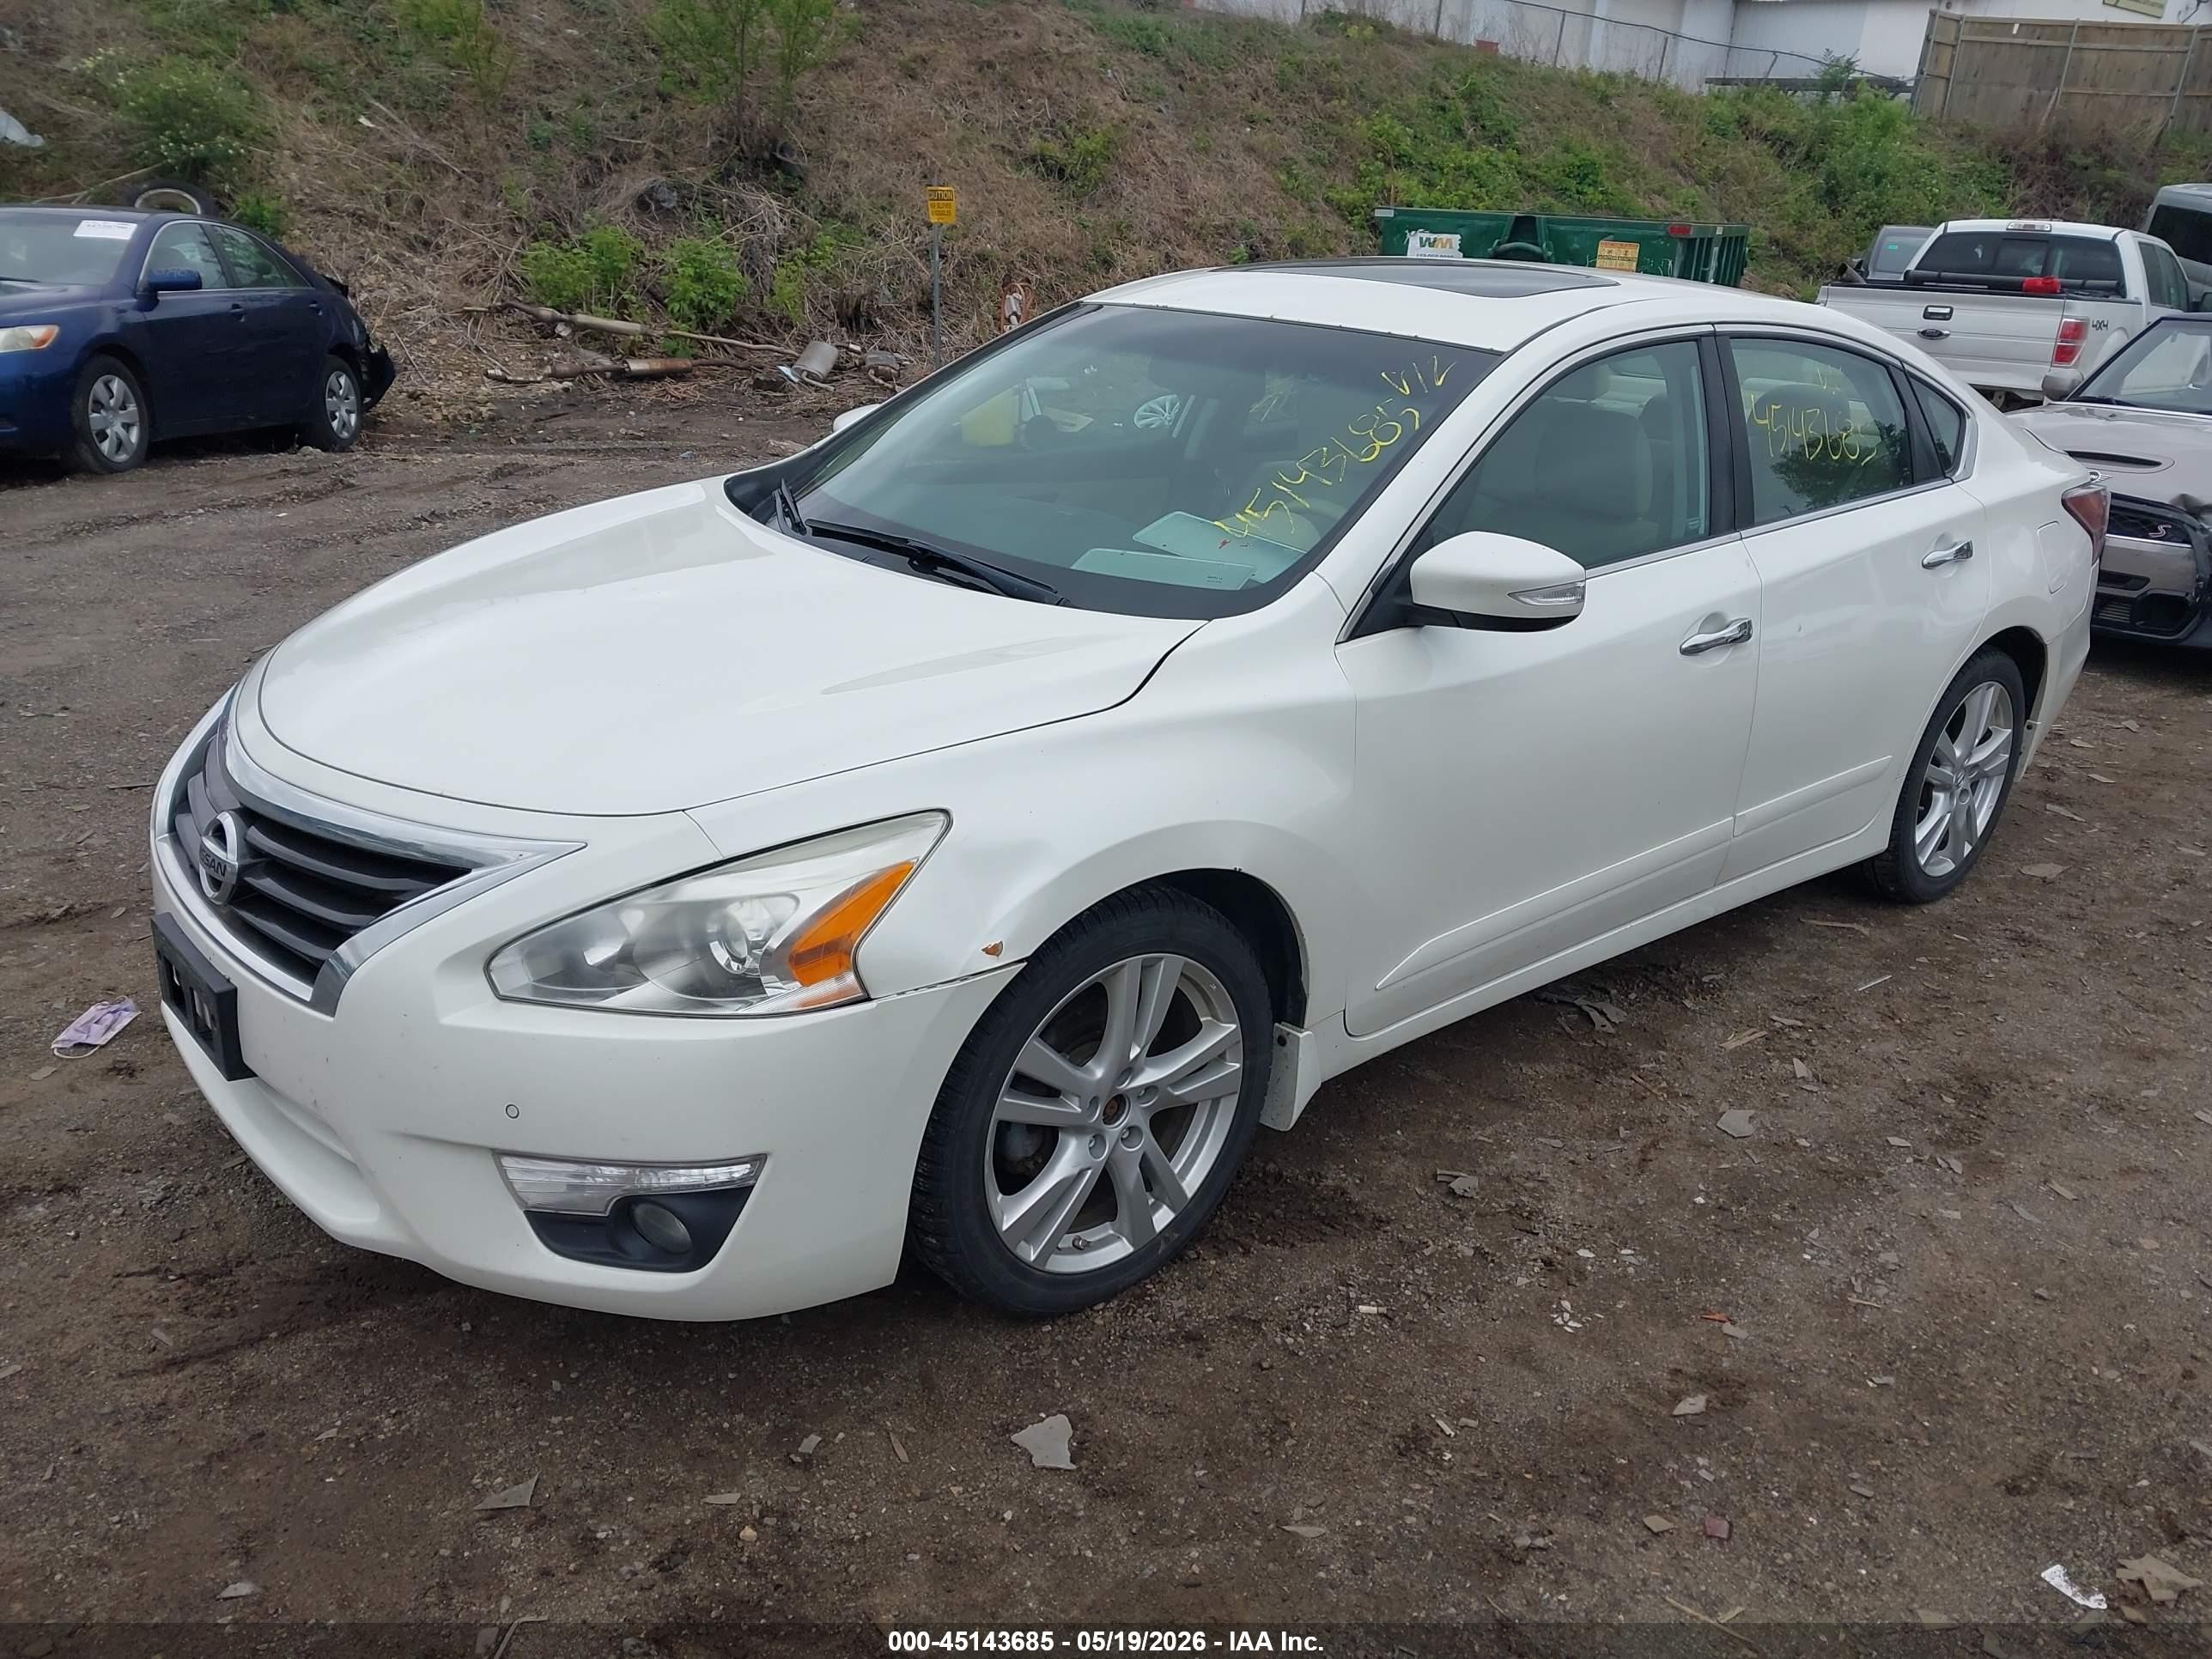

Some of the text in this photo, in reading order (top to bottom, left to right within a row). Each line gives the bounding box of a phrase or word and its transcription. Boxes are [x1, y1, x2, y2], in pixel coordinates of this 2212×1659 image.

[932, 191, 953, 200] UTION
[1419, 236, 1453, 248] WM
[200, 848, 227, 877] SSAN
